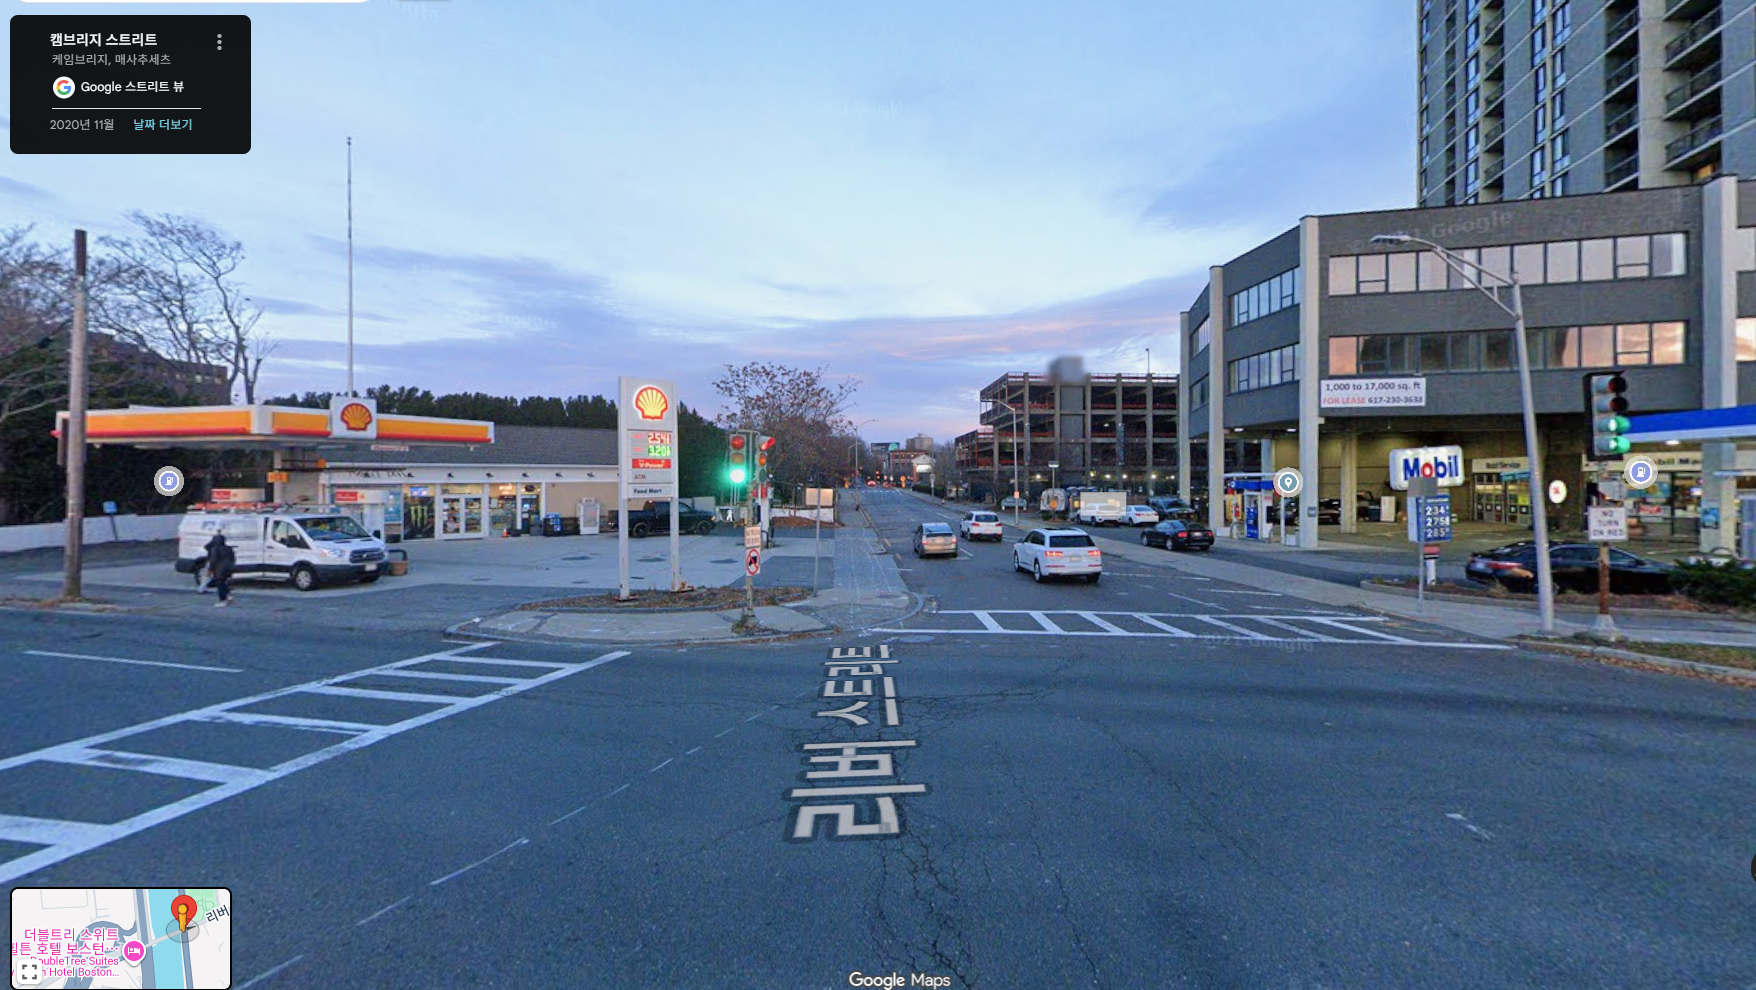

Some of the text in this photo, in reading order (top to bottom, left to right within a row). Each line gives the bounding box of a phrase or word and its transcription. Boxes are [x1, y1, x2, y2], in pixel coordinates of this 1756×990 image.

[1325, 383, 1350, 392] 1,000
[1365, 382, 1395, 391] 17,000
[1323, 396, 1340, 405] FOR
[1342, 396, 1366, 404] LEASE
[1403, 455, 1459, 480] Mobil
[1602, 510, 1614, 518] NO
